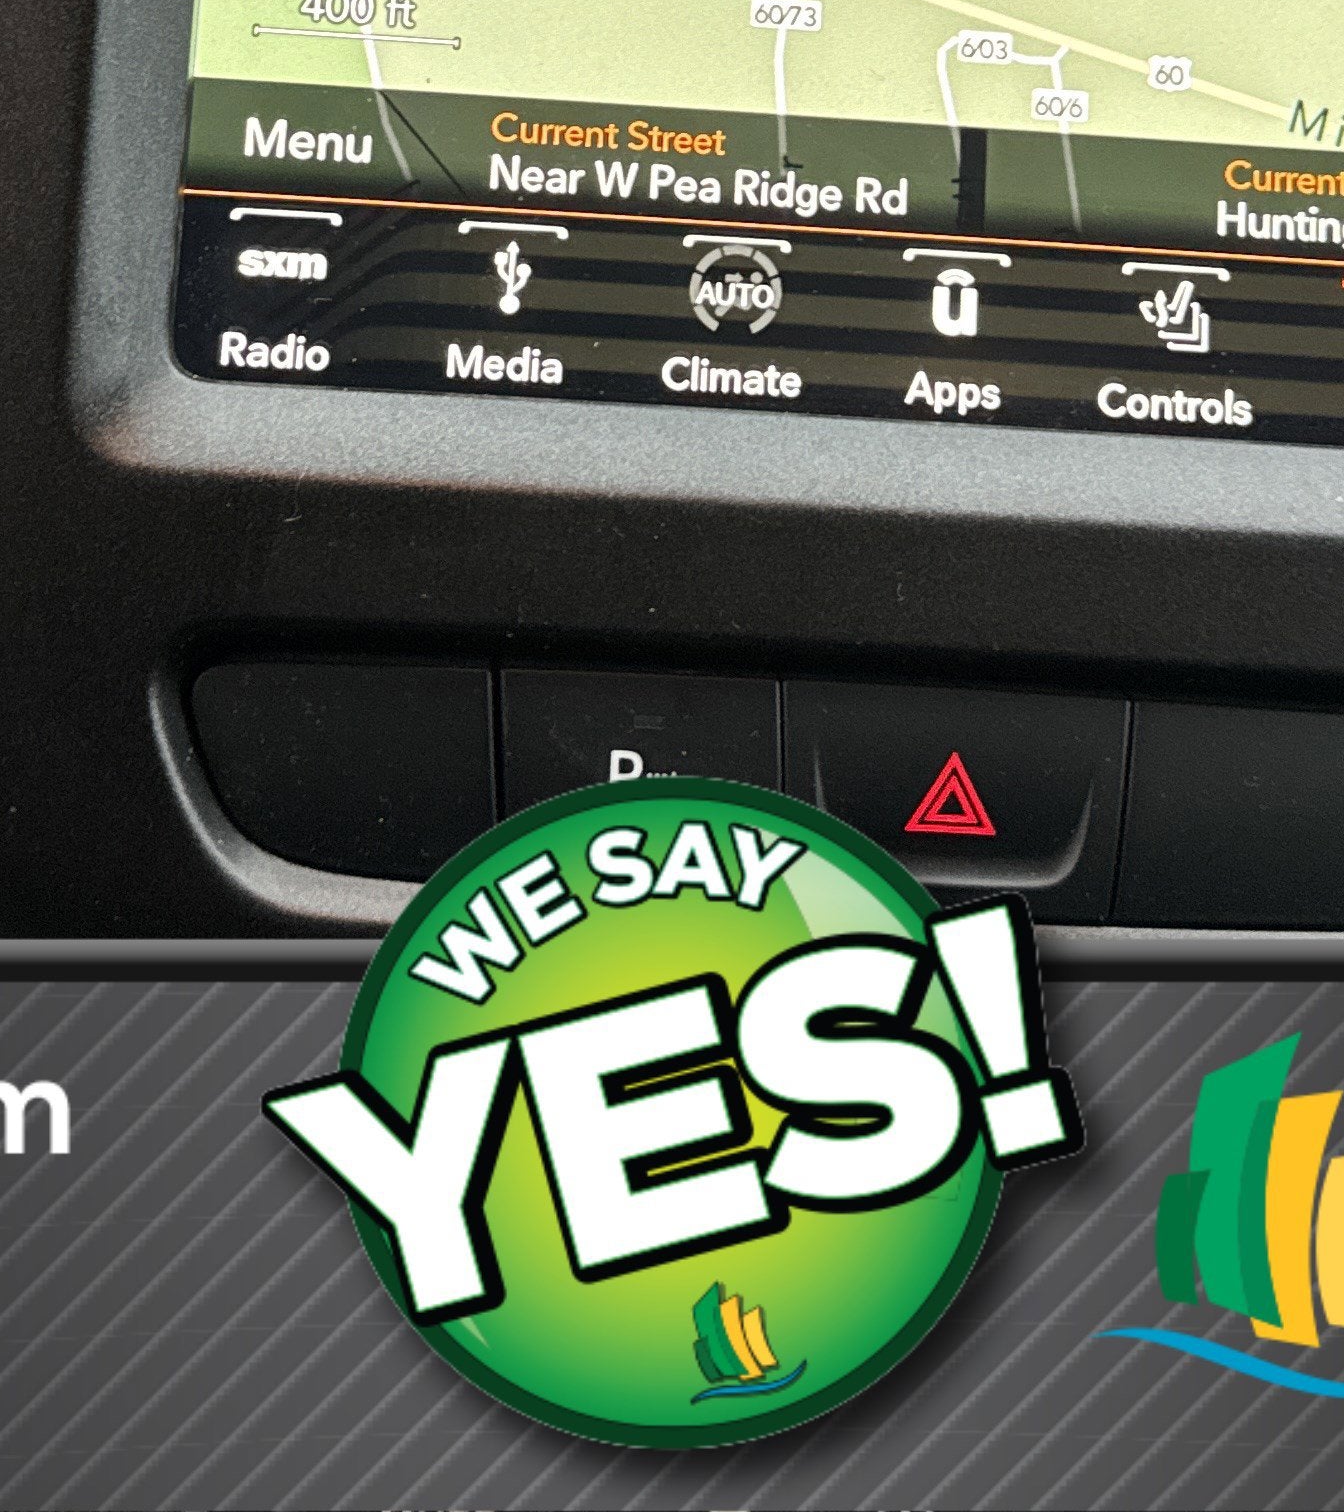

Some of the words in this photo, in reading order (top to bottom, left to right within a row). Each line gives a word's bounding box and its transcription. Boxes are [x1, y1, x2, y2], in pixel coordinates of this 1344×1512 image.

[1154, 64, 1185, 87] 60
[242, 115, 374, 165] Menu
[489, 110, 620, 149] Current
[626, 118, 726, 156] Street
[488, 152, 587, 196] Near
[593, 158, 641, 199] W
[648, 162, 723, 205] Pea
[732, 167, 845, 219] Ridge
[854, 175, 910, 217] Rd
[236, 247, 329, 282] sxm
[695, 280, 775, 310] AUTO
[218, 329, 331, 373] Radio
[444, 342, 565, 385] Media
[660, 354, 803, 399] Climate
[902, 369, 1003, 417] Apps
[1096, 381, 1254, 427] Controls
